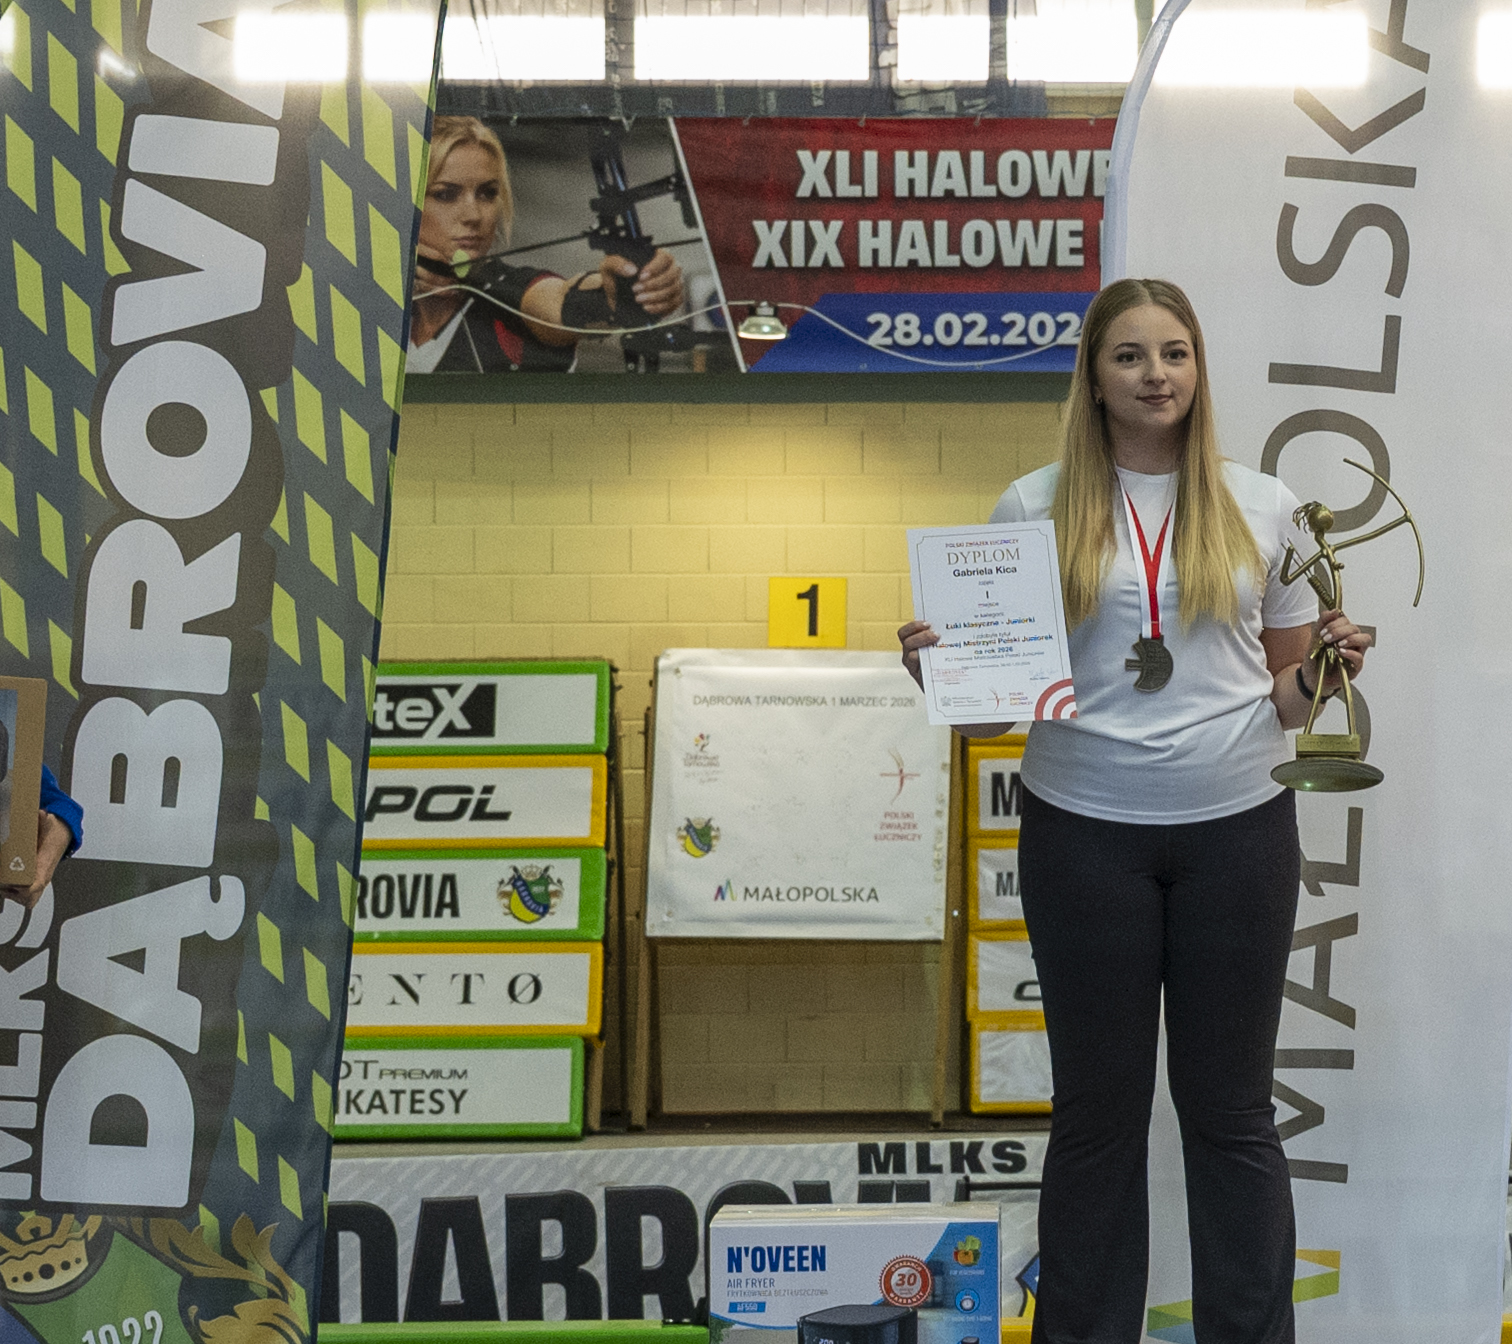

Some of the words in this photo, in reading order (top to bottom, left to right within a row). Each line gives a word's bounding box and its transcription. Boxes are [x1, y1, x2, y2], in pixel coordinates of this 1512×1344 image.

[796, 150, 878, 198] XLI
[752, 219, 845, 268] XIX
[858, 219, 1085, 268] HALOWE
[866, 311, 1088, 347] 28.02.202
[947, 547, 1021, 566] DYPLOM
[953, 566, 994, 578] Gabriela
[995, 565, 1018, 575] Kica
[796, 583, 820, 638] 1
[693, 695, 752, 710] DĄBROWA
[754, 694, 828, 708] TARNOWSKA
[838, 694, 888, 707] MARZEC
[890, 694, 917, 707] 2026
[743, 884, 880, 904] MAŁOPOLSKA
[379, 1068, 468, 1080] PREMIUM
[857, 1140, 1028, 1175] MLKS
[726, 1244, 827, 1274] N'OVEEN
[727, 1278, 745, 1289] AIR
[747, 1277, 776, 1289] FRYER
[895, 1273, 918, 1288] 30
